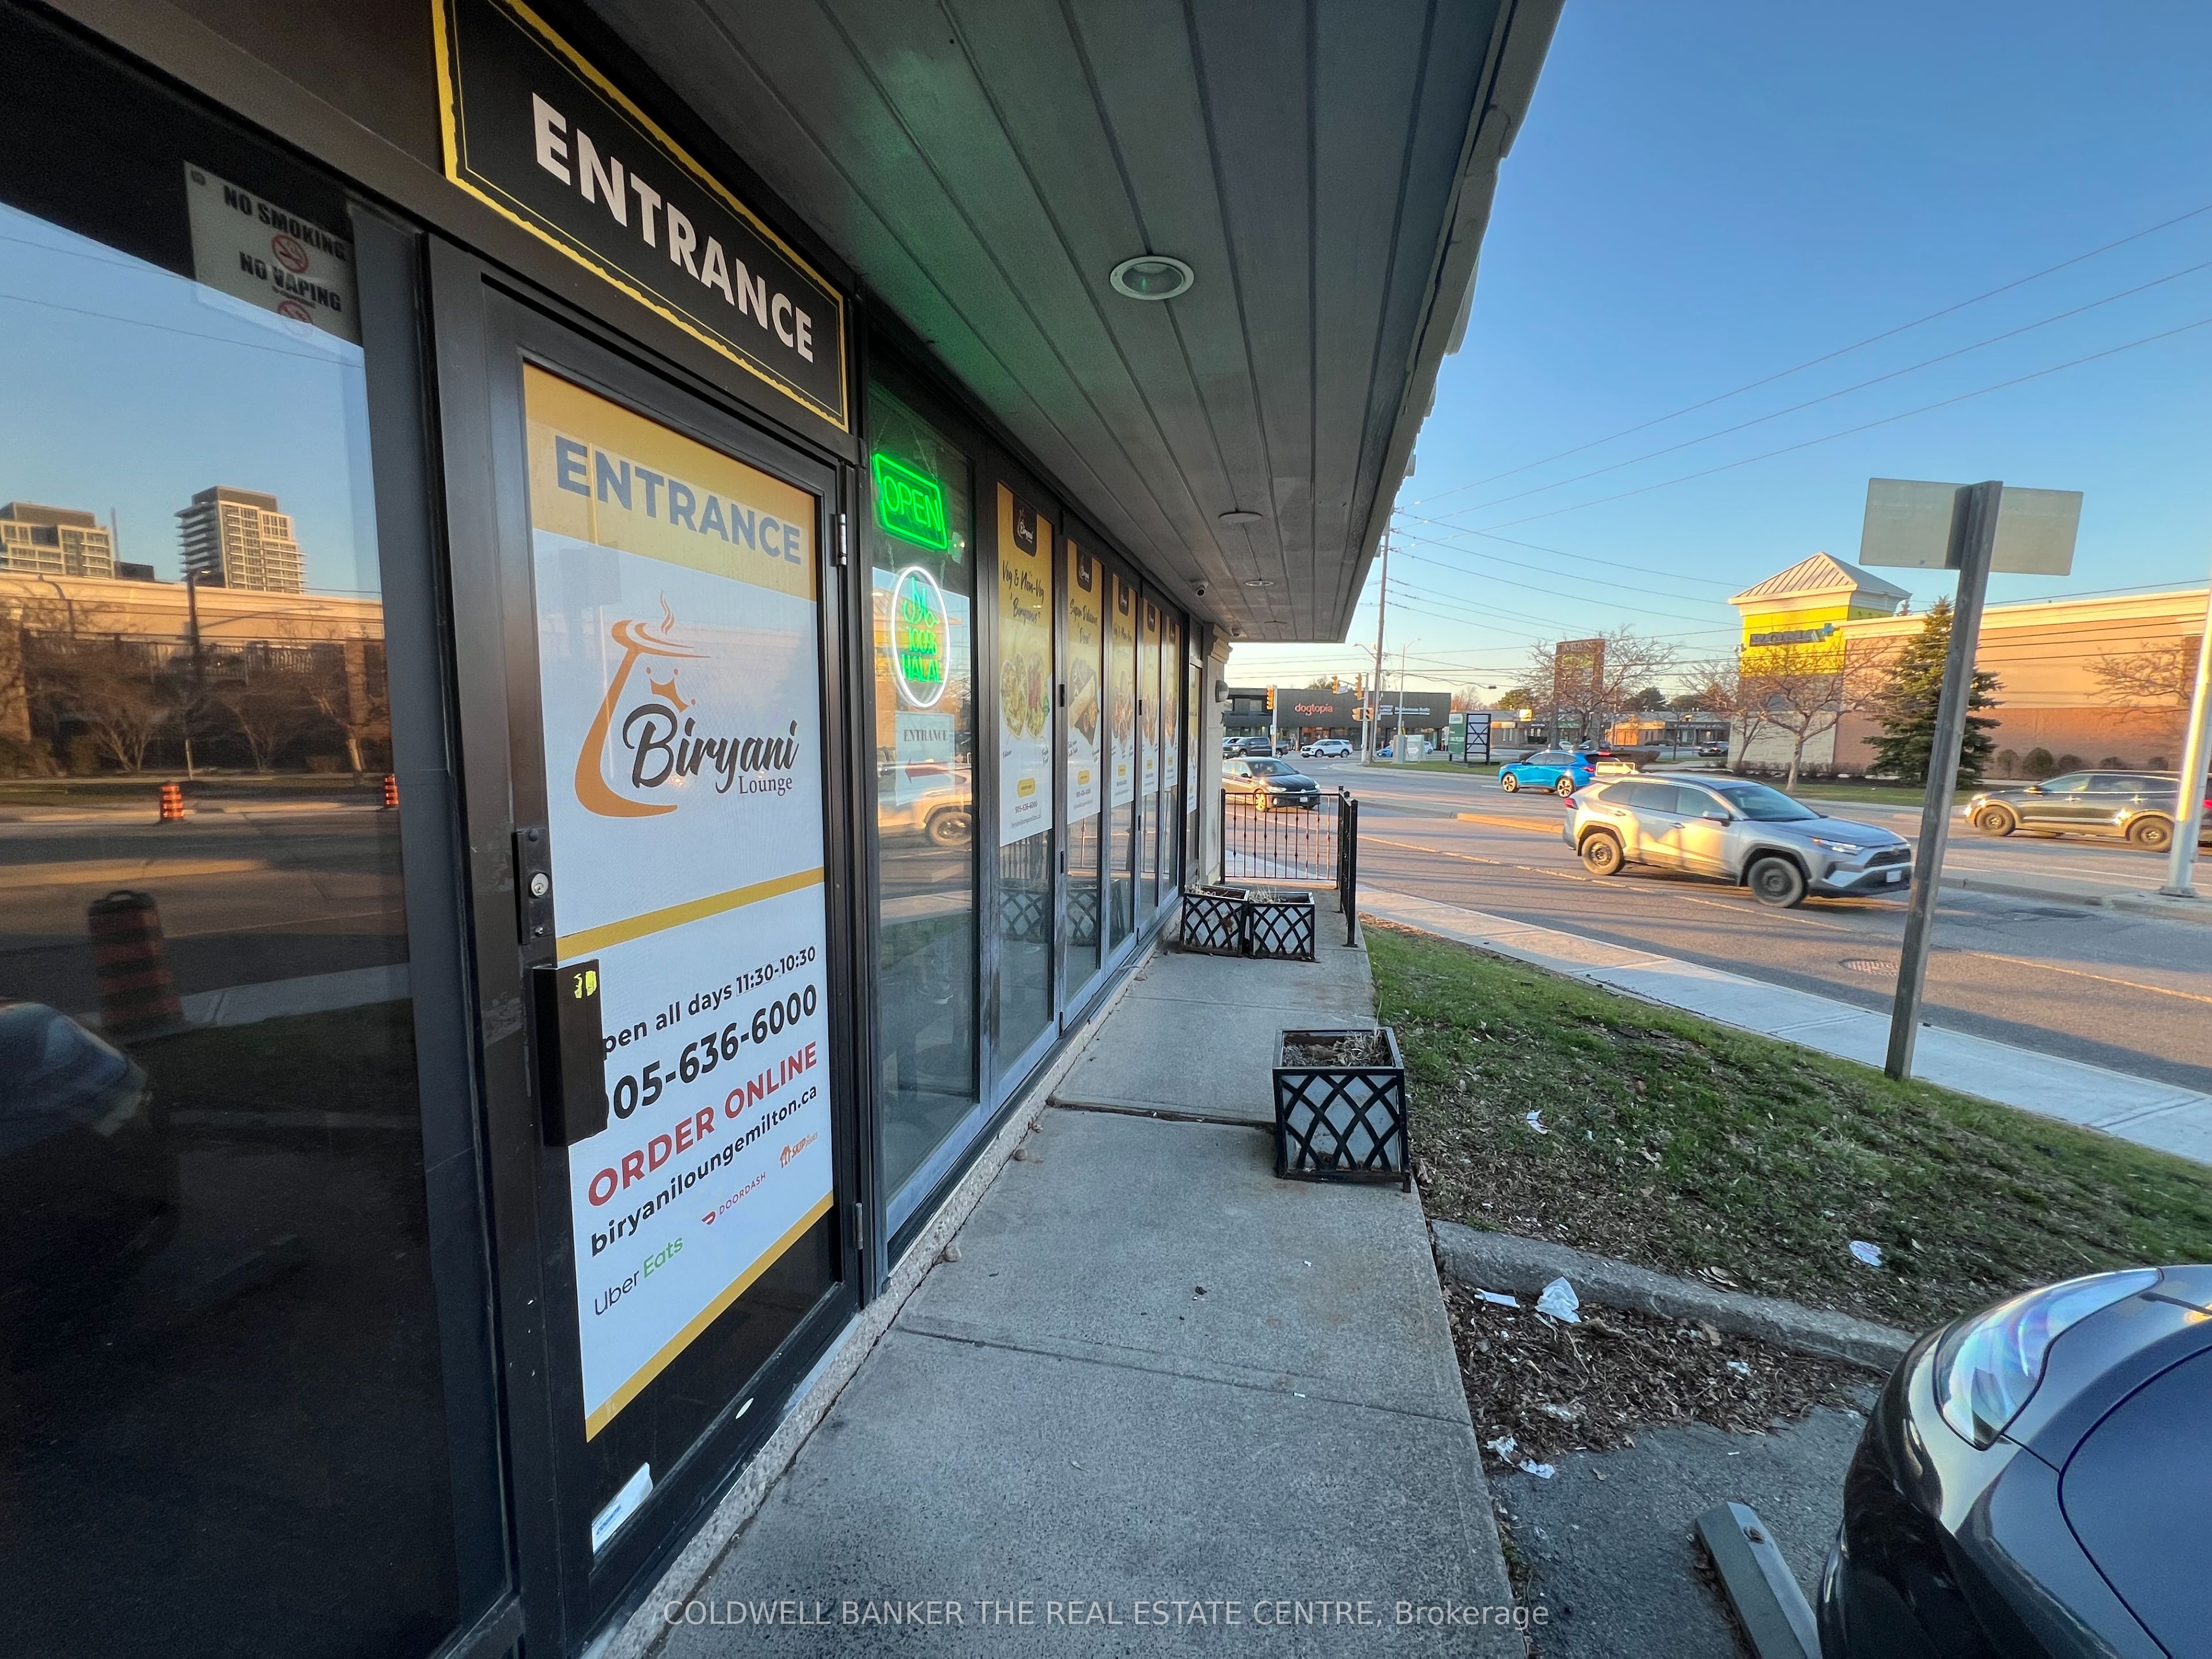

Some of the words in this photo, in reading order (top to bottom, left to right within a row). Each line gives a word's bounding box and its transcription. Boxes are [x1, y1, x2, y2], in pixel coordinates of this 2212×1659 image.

[222, 184, 253, 216] NO
[257, 202, 346, 262] SMOKING
[532, 92, 814, 363] ENTRANCE
[238, 251, 268, 281] NO
[271, 265, 342, 313] VAPING
[555, 434, 802, 566] ENTRANCE
[883, 475, 942, 533] OPEN
[1002, 560, 1013, 590] Veg
[902, 653, 944, 684] HALAL
[906, 626, 938, 656] 100%
[903, 729, 949, 743] ENTRANCE
[1294, 703, 1334, 716] dogtopia
[622, 703, 799, 794] Biryani
[738, 775, 793, 797] Lounge
[603, 1021, 647, 1060] pen
[655, 1001, 681, 1031] all
[687, 982, 733, 1018] days
[736, 945, 816, 995] 11:30-10:30
[606, 984, 817, 1120] 05-636-6000
[588, 1106, 715, 1207] ORDER
[724, 1041, 817, 1119] ONLINE
[591, 1085, 817, 1257] biryaniloungemilton.ca
[719, 1171, 766, 1215] DOORDASH
[594, 1267, 640, 1316] Uber
[643, 1236, 684, 1279] Eats
